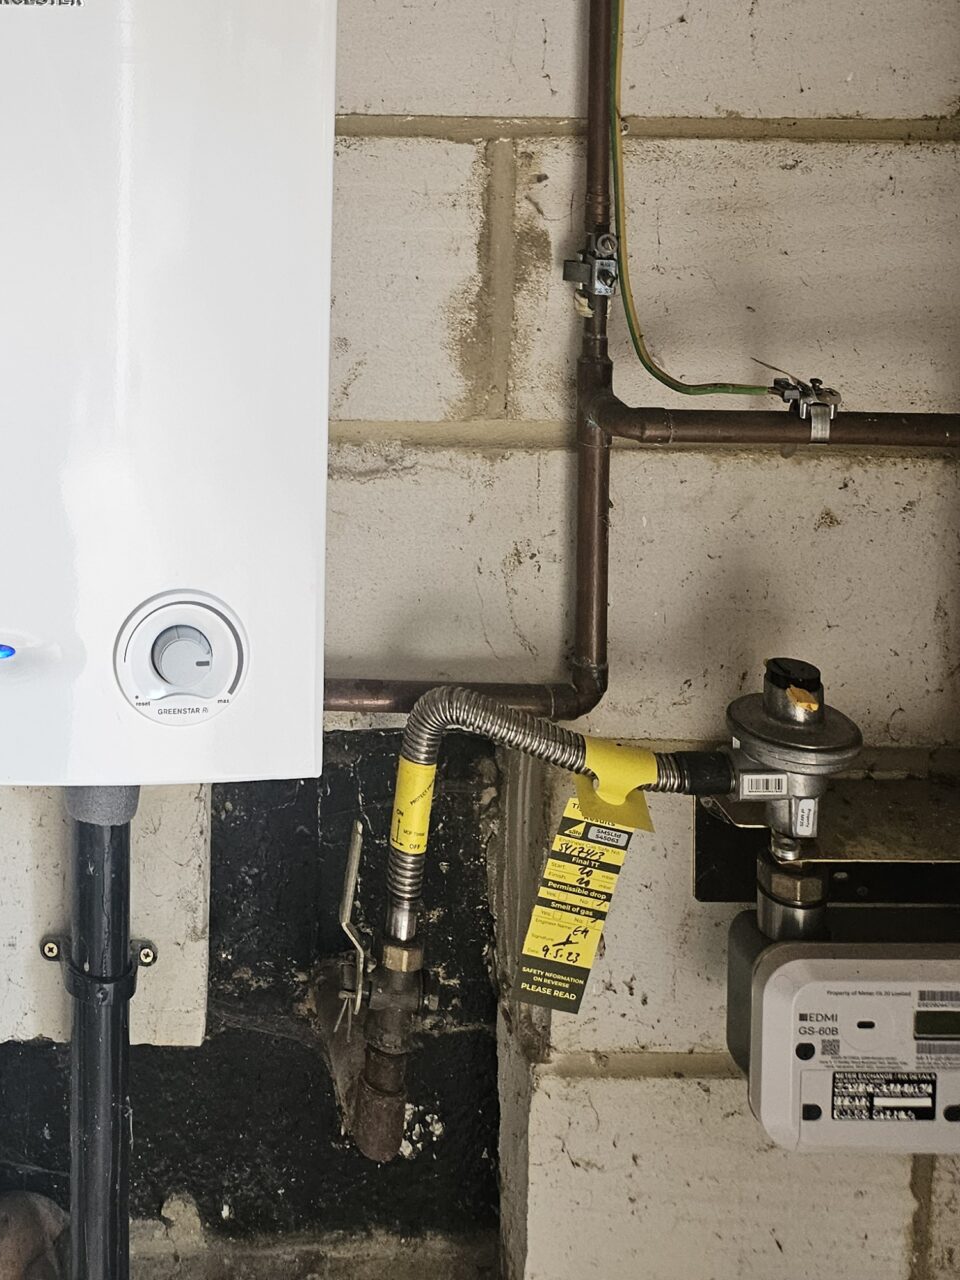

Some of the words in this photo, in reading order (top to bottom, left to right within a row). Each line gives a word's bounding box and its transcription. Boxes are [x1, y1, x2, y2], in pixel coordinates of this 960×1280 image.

[157, 707, 200, 715] GREENSTAR
[571, 856, 589, 865] Final
[547, 880, 588, 896] Permissible
[589, 890, 607, 900] drop
[550, 901, 570, 911] Smell
[579, 908, 593, 917] gas
[521, 966, 543, 976] SAFETY
[543, 978, 569, 988] REVERSE
[520, 981, 552, 995] PLEASE
[553, 989, 576, 1001] READ
[809, 1013, 838, 1022] EDMI
